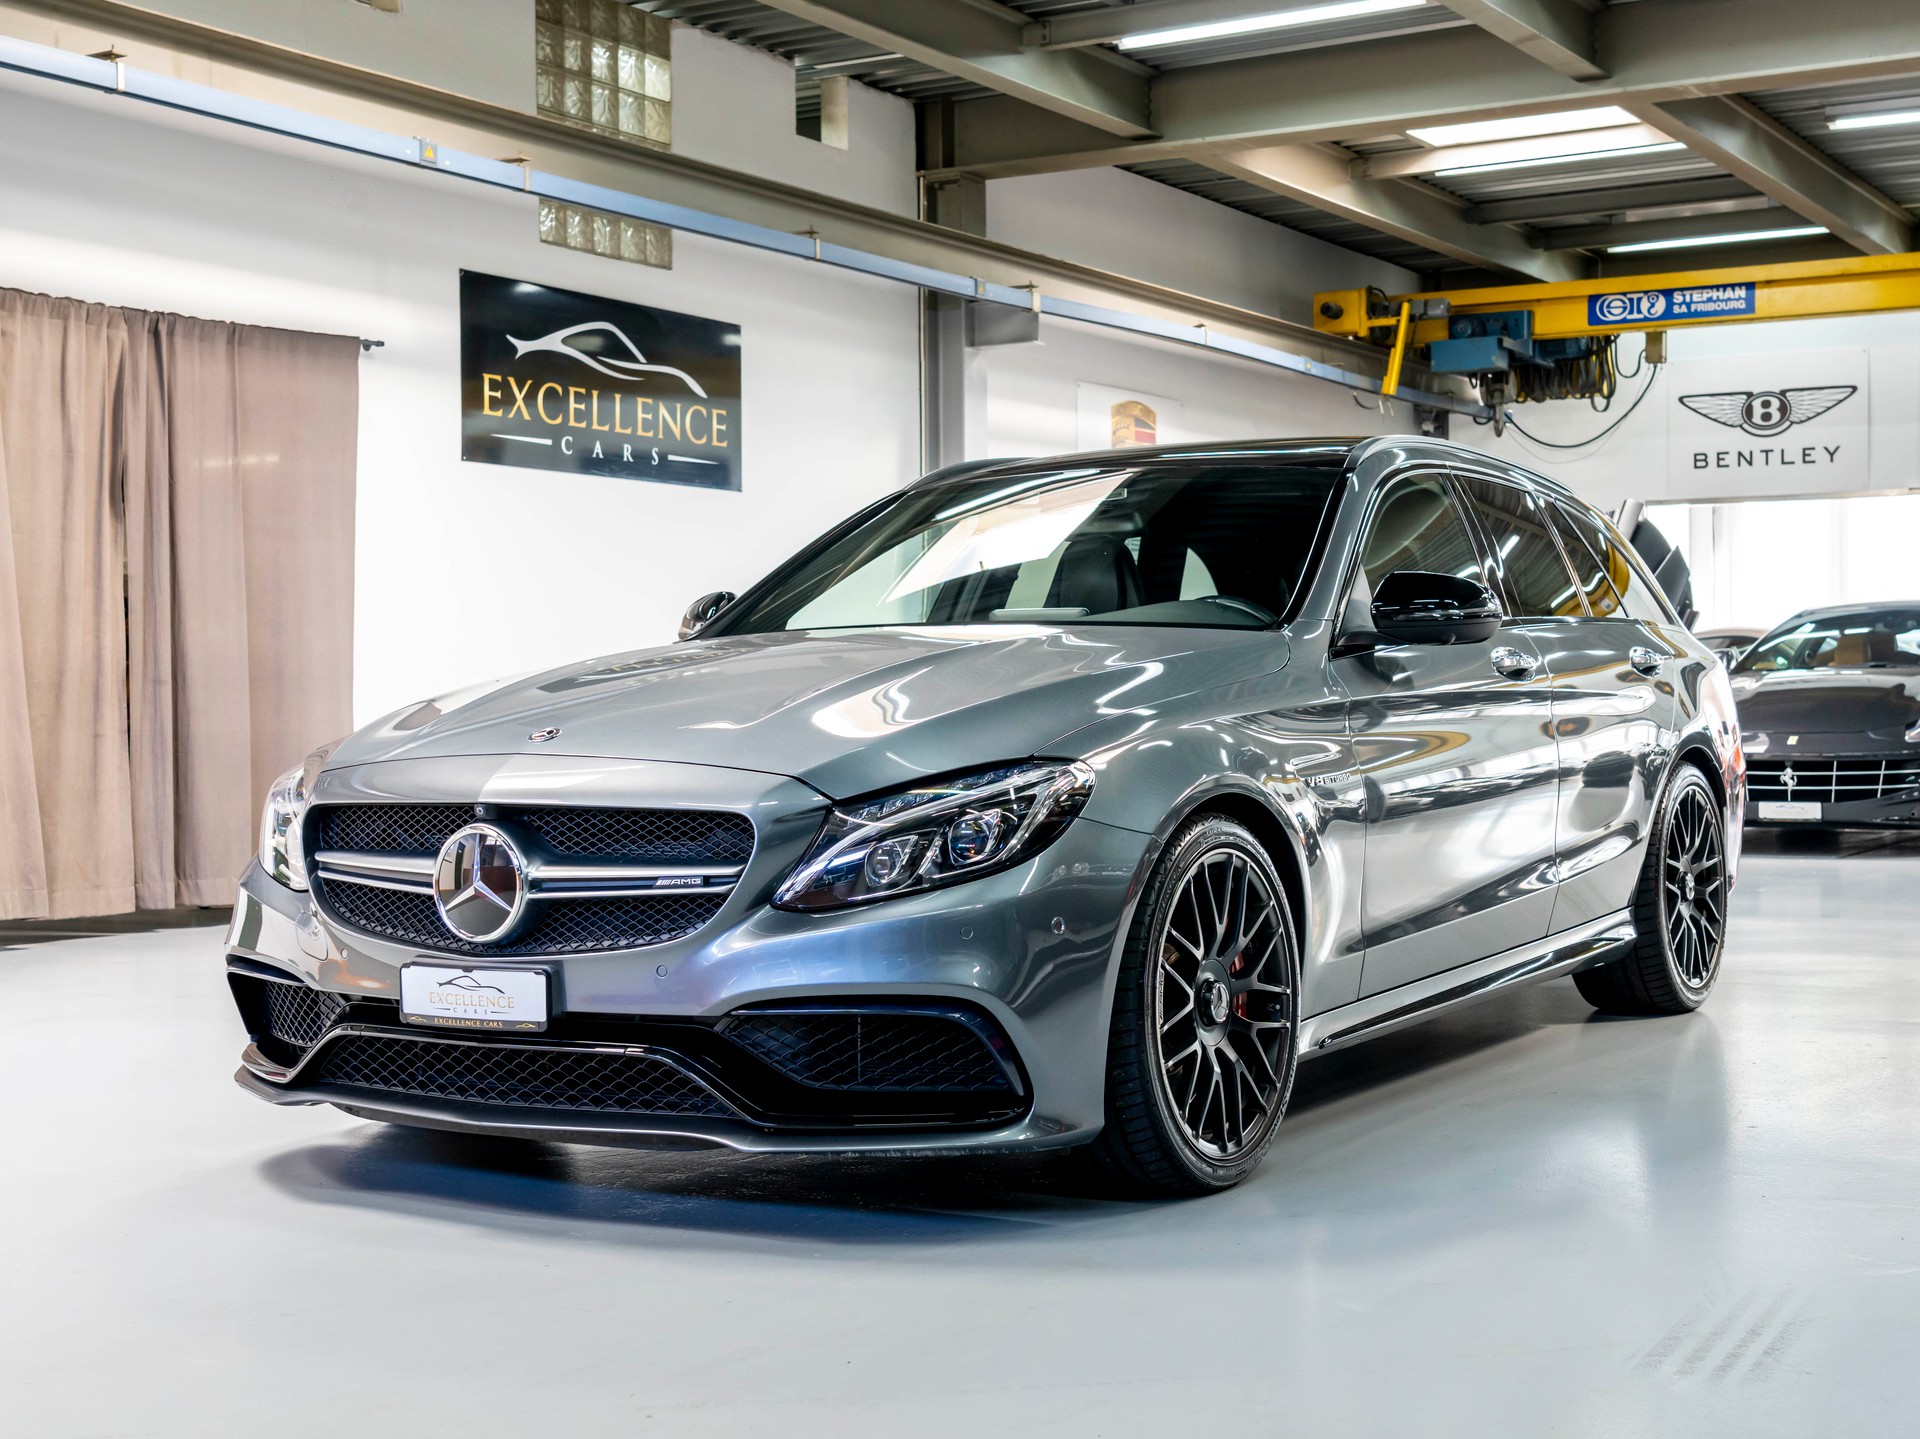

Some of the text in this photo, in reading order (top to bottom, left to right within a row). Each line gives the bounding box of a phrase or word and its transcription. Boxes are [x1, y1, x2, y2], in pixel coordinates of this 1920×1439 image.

[1673, 286, 1746, 304] STEPHAN
[1673, 300, 1746, 314] SA FRIBOURG
[482, 373, 728, 447] EXCELLENCE
[561, 436, 659, 465] CARS
[1693, 445, 1841, 469] BENTLEY
[1325, 773, 1351, 784] BITURBO
[430, 992, 514, 1009] EXCELLENCE
[453, 1007, 488, 1015] CARS
[434, 1017, 503, 1028] EXCELLENCE CARS
